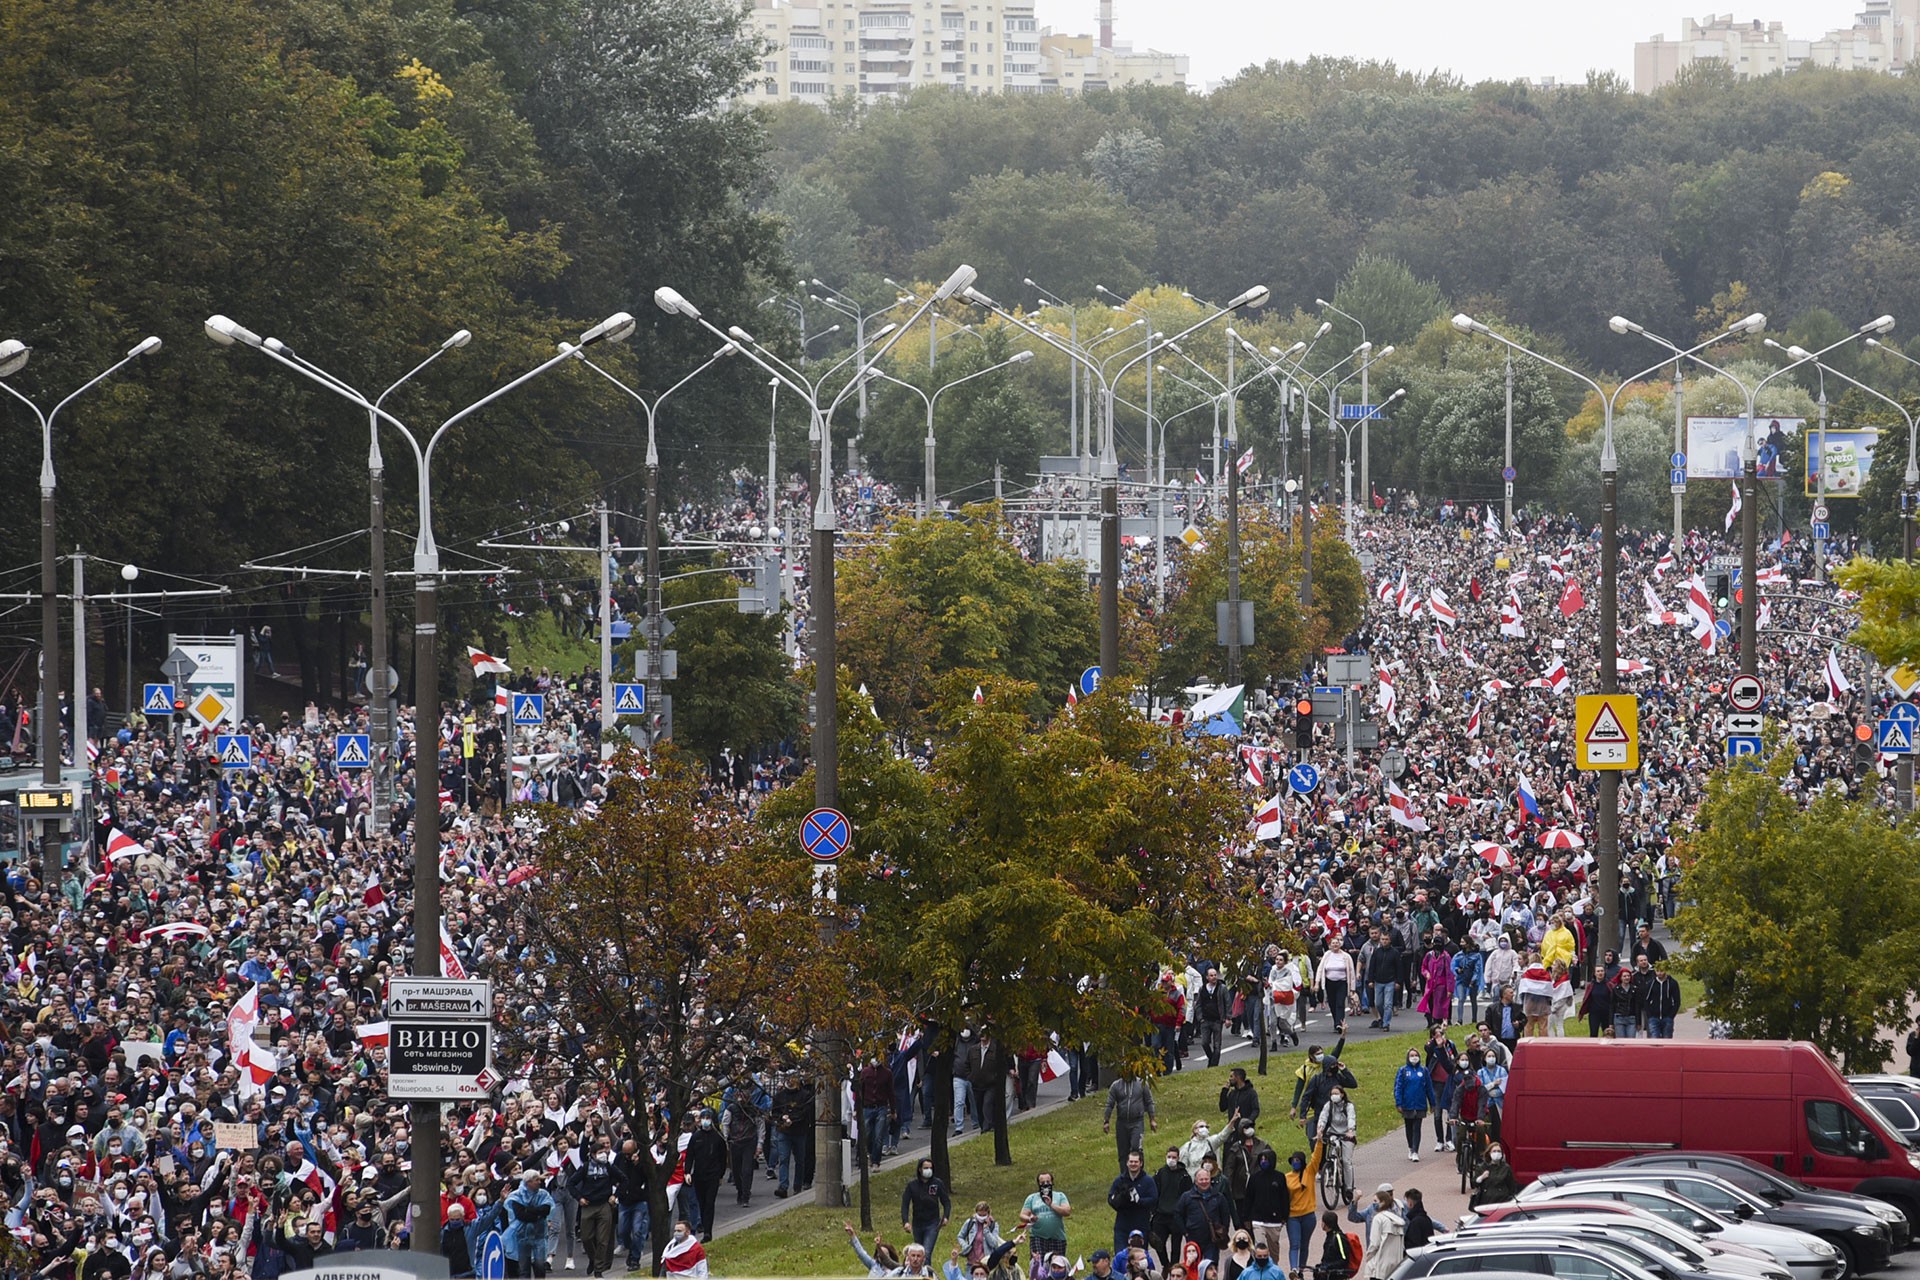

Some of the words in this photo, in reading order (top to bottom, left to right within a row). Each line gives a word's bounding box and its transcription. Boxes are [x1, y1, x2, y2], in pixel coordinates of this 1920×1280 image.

[1818, 509, 1826, 518] 70
[1608, 748, 1615, 758] 5
[402, 988, 420, 997] пр-т
[422, 988, 474, 996] МАШЭРАВА
[420, 1000, 469, 1011] MAŠERAVA
[397, 1030, 480, 1049] ВИНО
[403, 1050, 425, 1058] сеть
[426, 1050, 473, 1058] магазинов
[411, 1063, 462, 1074] sbswine.by
[459, 1085, 478, 1093] 40м
